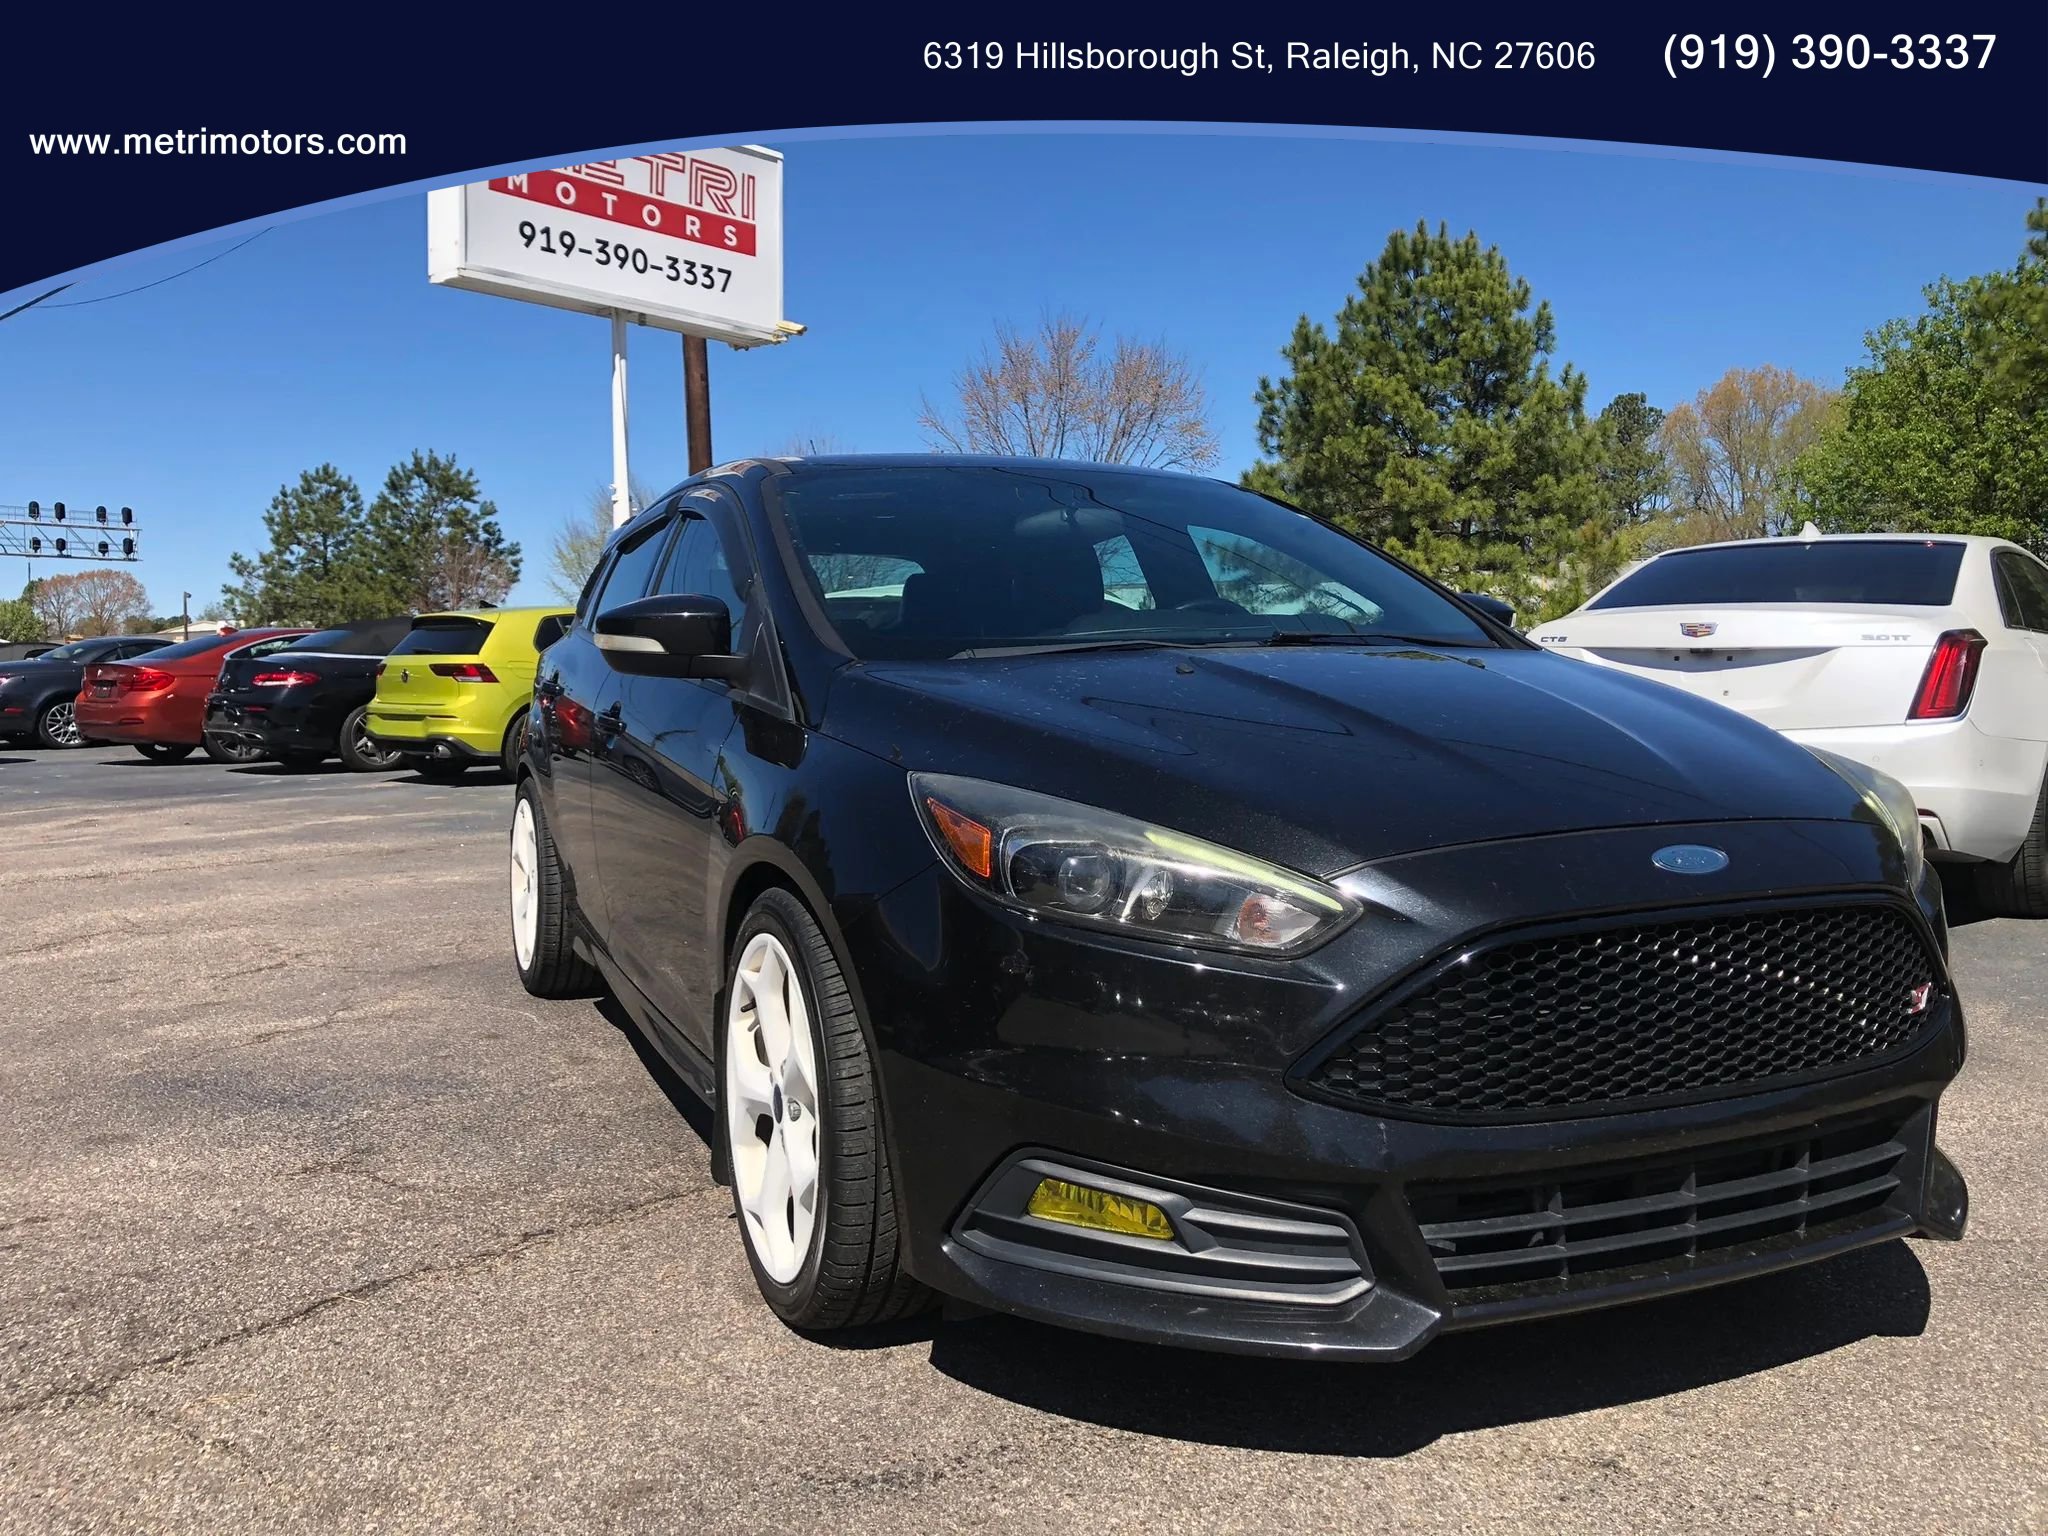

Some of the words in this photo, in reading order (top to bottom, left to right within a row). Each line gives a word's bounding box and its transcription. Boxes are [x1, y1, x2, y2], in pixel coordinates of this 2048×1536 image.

[507, 173, 738, 247] MOTORS
[563, 152, 756, 221] ETRI
[518, 220, 732, 293] 919-390-3337
